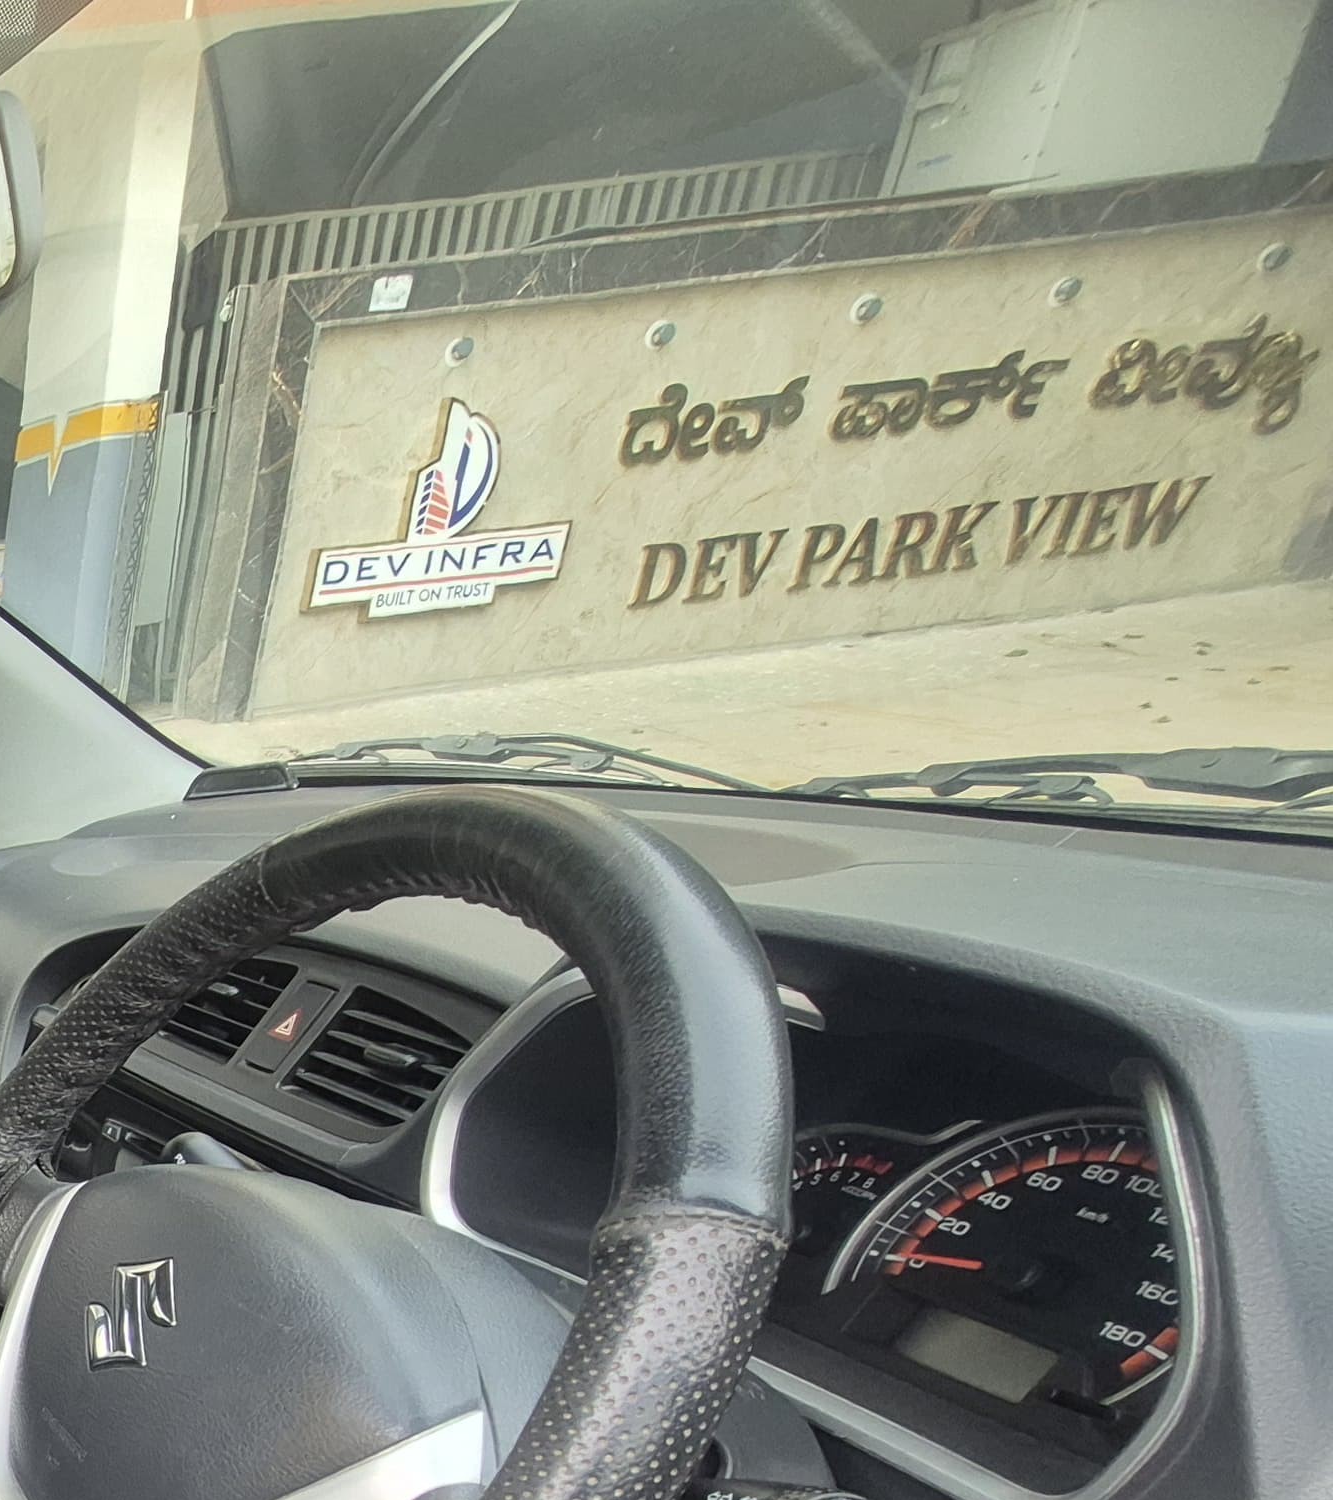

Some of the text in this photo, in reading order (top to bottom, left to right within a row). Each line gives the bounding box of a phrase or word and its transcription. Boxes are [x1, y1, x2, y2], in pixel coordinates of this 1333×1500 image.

[628, 474, 1213, 610] DEV PARK VIEW
[321, 538, 554, 585] DEV INFRA
[375, 582, 489, 608] BUILT ON TRUST
[809, 1173, 822, 1186] 5
[829, 1170, 842, 1182] 6
[848, 1171, 861, 1184] 7
[862, 1177, 876, 1189] 8
[1026, 1172, 1063, 1192] 60
[1081, 1164, 1119, 1185] 80
[977, 1191, 1013, 1211] 40
[1148, 1206, 1170, 1226] 12
[937, 1217, 971, 1236] 20
[1150, 1243, 1176, 1263] 14
[1099, 1321, 1147, 1347] 180
